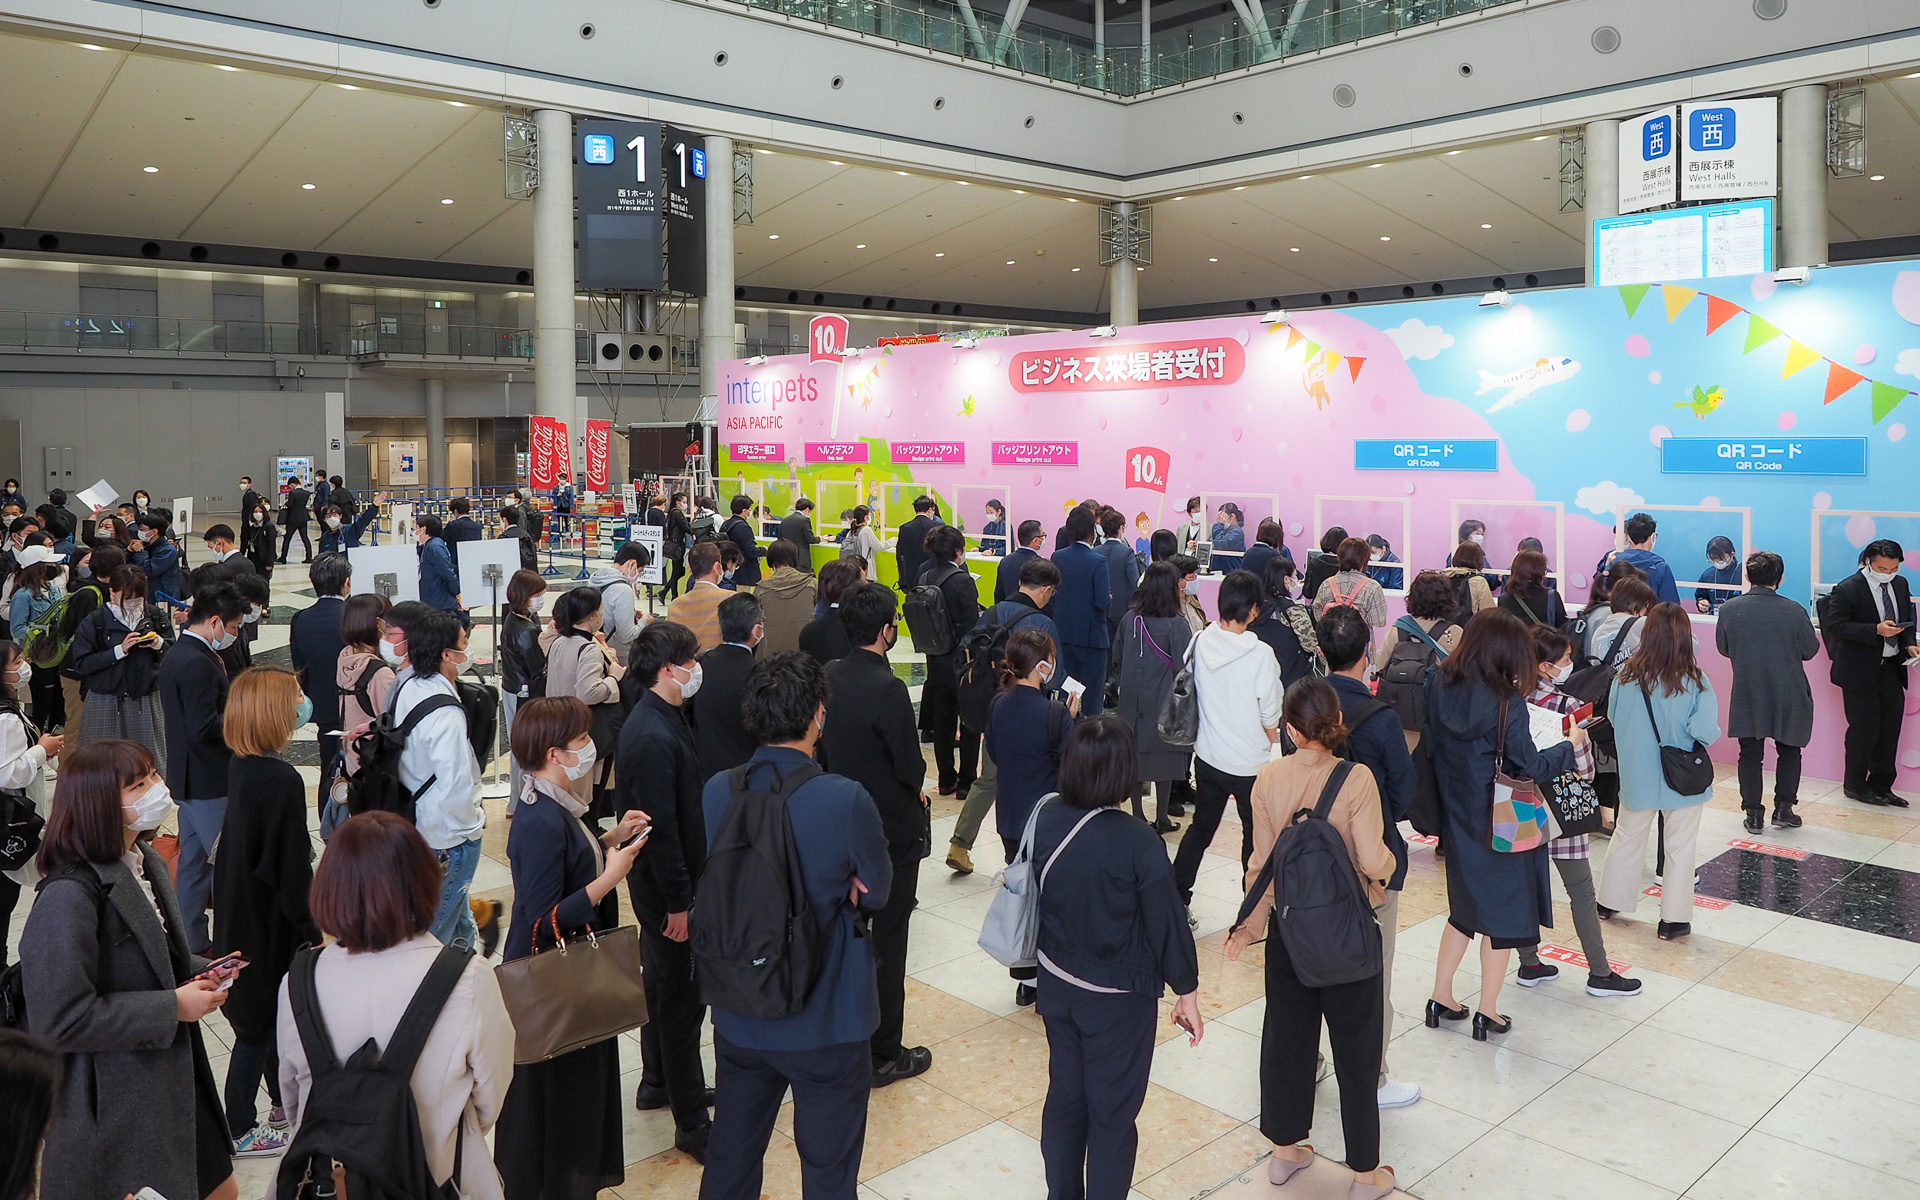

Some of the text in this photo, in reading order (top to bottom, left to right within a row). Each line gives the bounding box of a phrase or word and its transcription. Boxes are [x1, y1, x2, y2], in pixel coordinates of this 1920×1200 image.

[1701, 113, 1723, 122] West
[1650, 121, 1664, 132] West
[1702, 123, 1723, 147] 西
[1650, 131, 1664, 157] 西
[593, 145, 606, 161] 西
[627, 135, 646, 182] 1
[675, 143, 686, 188] 1
[1689, 160, 1735, 172] 西展示棟
[1642, 165, 1671, 182] 西展示棟
[1689, 172, 1736, 182] West Halls
[1642, 178, 1672, 192] West Halls
[618, 188, 655, 198] 西1ホール
[1022, 345, 1226, 385] ビジネス来場者受付
[727, 373, 818, 411] interpets
[727, 415, 783, 430] ASIA PACIFIC
[816, 444, 854, 455] ヘルプデスク
[896, 444, 960, 455] バッジプリントアウト
[997, 444, 1072, 456] バッジプリントアウト
[1393, 444, 1454, 457] QR コード
[1716, 443, 1803, 459] QR コード
[1407, 459, 1440, 467] QR Code
[1735, 461, 1783, 470] QR Code
